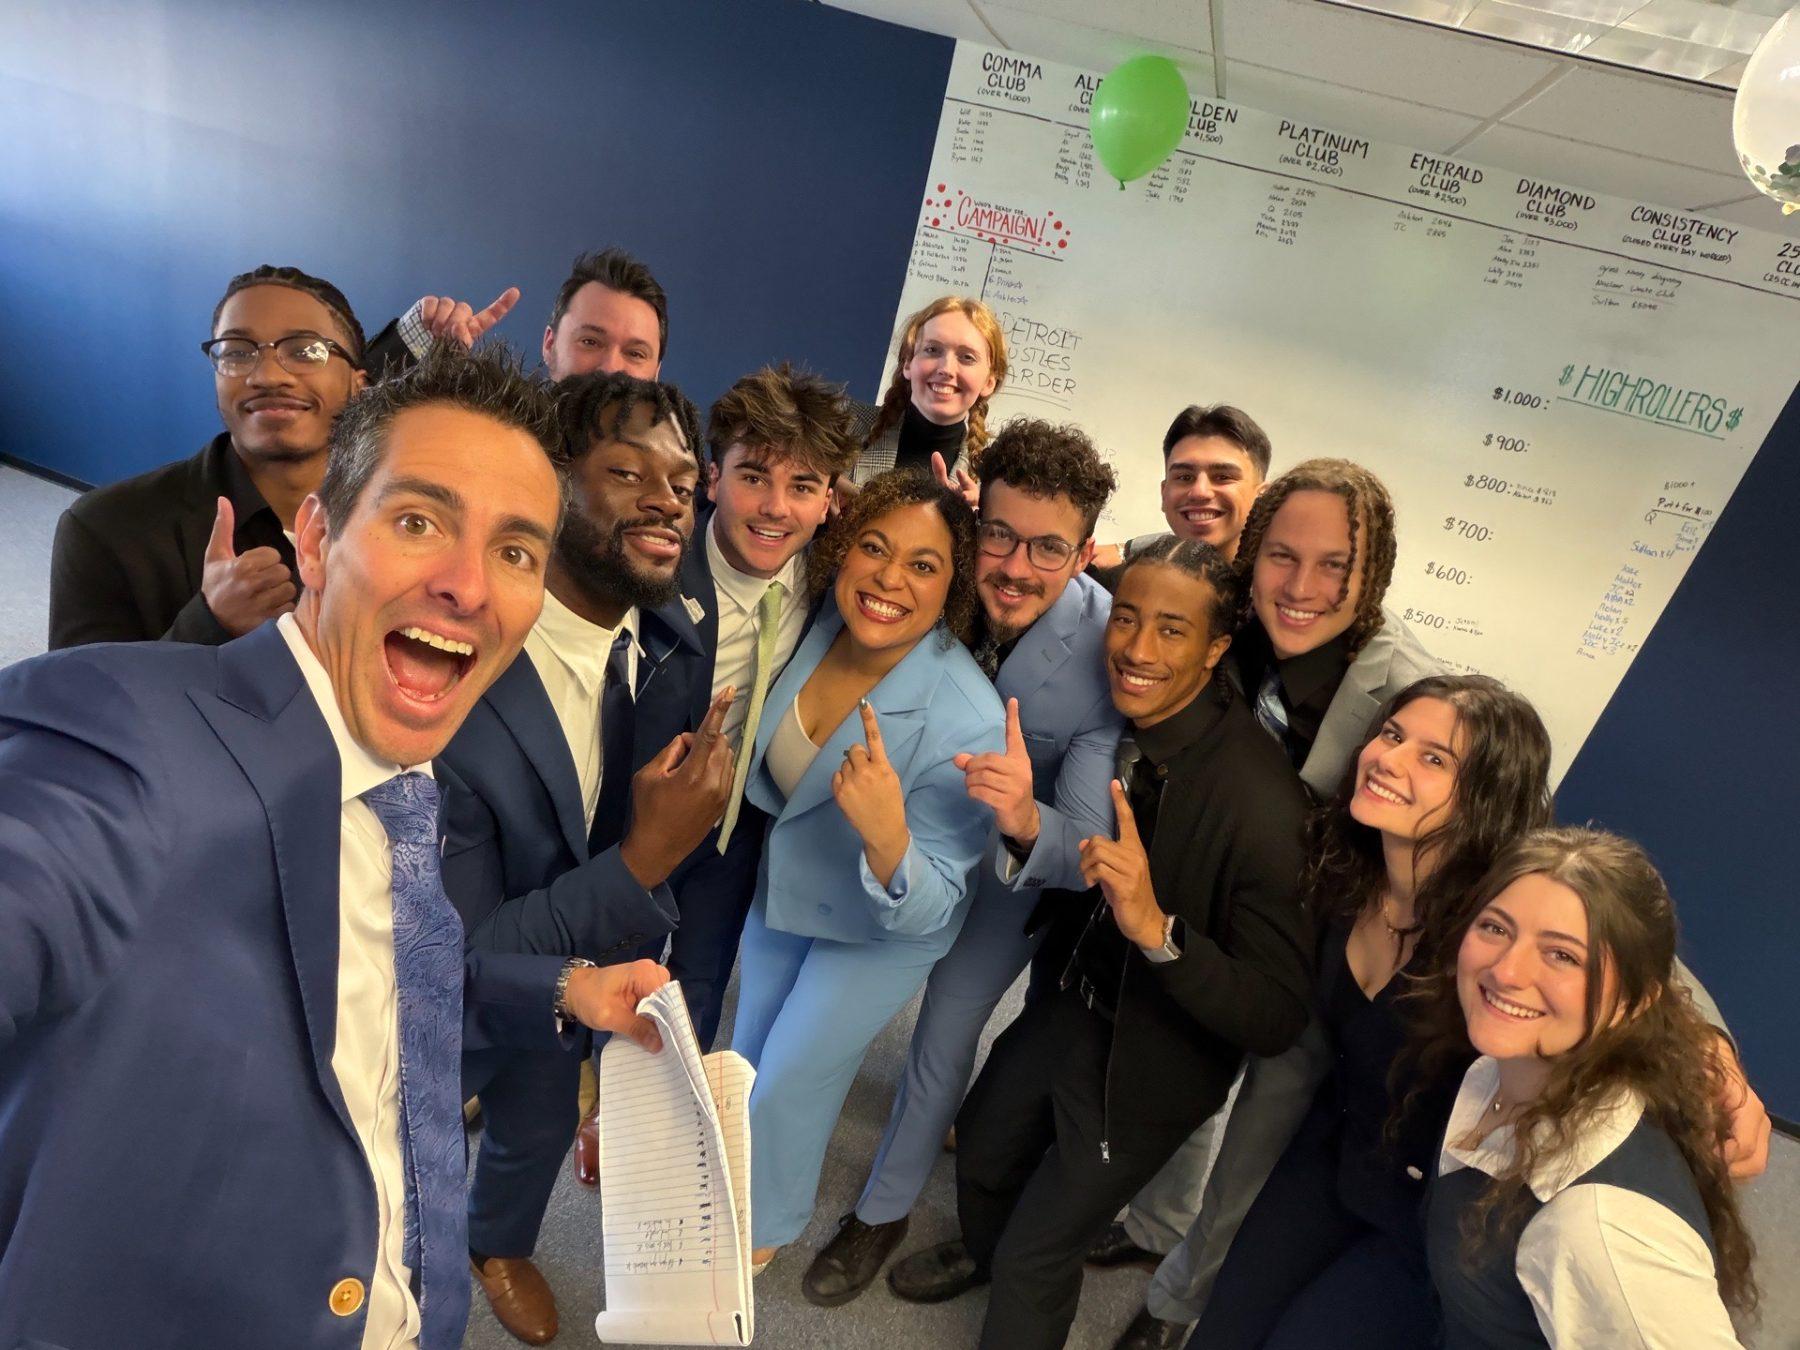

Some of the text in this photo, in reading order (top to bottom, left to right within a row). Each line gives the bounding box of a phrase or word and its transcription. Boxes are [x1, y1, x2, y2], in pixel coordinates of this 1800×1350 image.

[982, 52, 1042, 80] COMMA
[977, 87, 1001, 97] (OVER
[987, 73, 1026, 92] CLUB
[1189, 99, 1238, 123] LDEN
[1188, 116, 1217, 133] LUB
[1278, 120, 1370, 159] PLATINUM
[1279, 155, 1302, 167] (OVER
[1295, 142, 1340, 166] CLUB
[1410, 153, 1484, 184] EMERALD
[1408, 184, 1431, 197] (OVER
[1420, 173, 1461, 194] CLUB
[1516, 178, 1596, 210] DIAMOND
[957, 195, 1047, 243] CAMPAIGN!
[995, 205, 1012, 213] READY
[1515, 210, 1539, 222] (OVER
[1526, 199, 1566, 218] CLUB
[1631, 205, 1738, 245] CONSISTENCY
[1652, 228, 1692, 247] CLUB
[1654, 242, 1679, 253] EVERY
[1681, 247, 1697, 256] DAY
[1700, 251, 1732, 265] WORKED)
[1002, 312, 1082, 351] DETROIT
[1008, 346, 1071, 371] USTLES
[1006, 364, 1077, 394] ARDER
[1573, 365, 1728, 433] HIGHROLLERS
[1482, 433, 1531, 453] $900:
[1464, 474, 1513, 495] $800:
[1443, 516, 1494, 542] $700:
[1424, 561, 1473, 586] $600:
[1403, 608, 1451, 631] $500:
